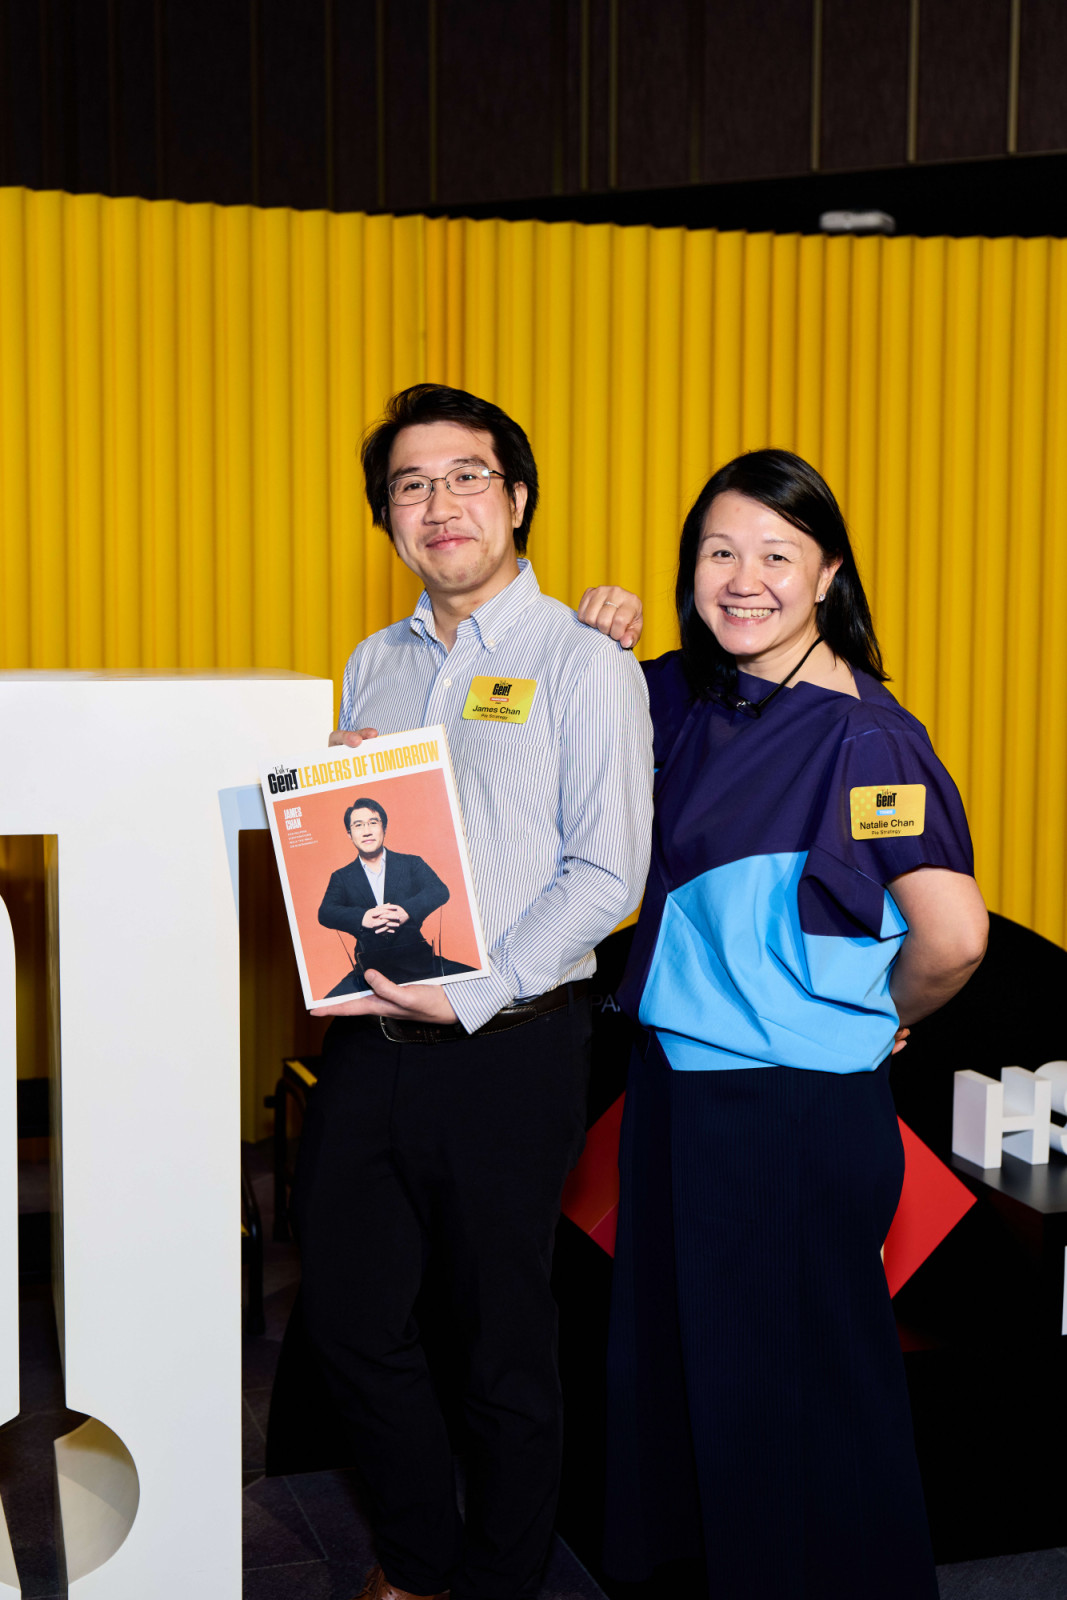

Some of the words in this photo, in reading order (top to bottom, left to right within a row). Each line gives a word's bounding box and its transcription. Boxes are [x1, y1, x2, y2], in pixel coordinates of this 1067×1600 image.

[473, 705, 498, 713] James
[500, 706, 521, 716] Chan
[298, 758, 352, 789] LEADERS
[353, 755, 369, 778] OF
[369, 740, 440, 774] TOMORROW
[876, 793, 897, 807] GenT
[283, 806, 302, 820] JAMES
[285, 818, 302, 831] CHAN
[860, 820, 888, 830] Natalie
[891, 819, 914, 828] Chan
